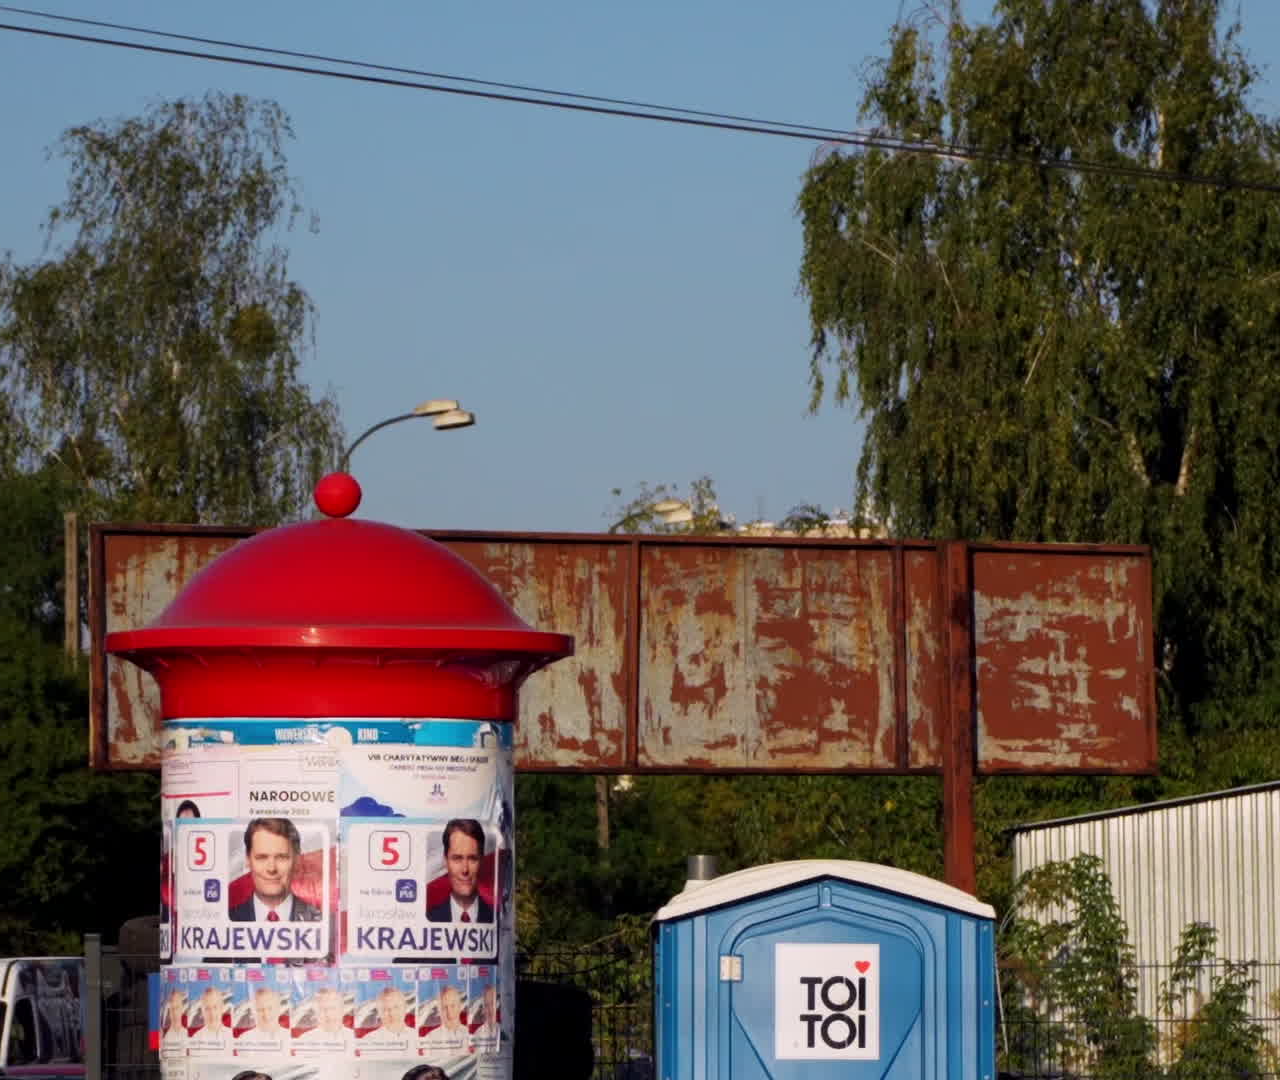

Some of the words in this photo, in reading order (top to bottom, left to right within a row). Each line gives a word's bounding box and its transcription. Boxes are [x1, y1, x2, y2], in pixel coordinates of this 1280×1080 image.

[249, 791, 335, 802] NARODOWE
[193, 837, 207, 866] 5
[381, 837, 400, 866] 5
[181, 927, 320, 951] KRAJEWSKI
[357, 927, 493, 952] KRAJEWSKI
[800, 976, 866, 1011] TOI
[800, 1013, 866, 1050] TOI
